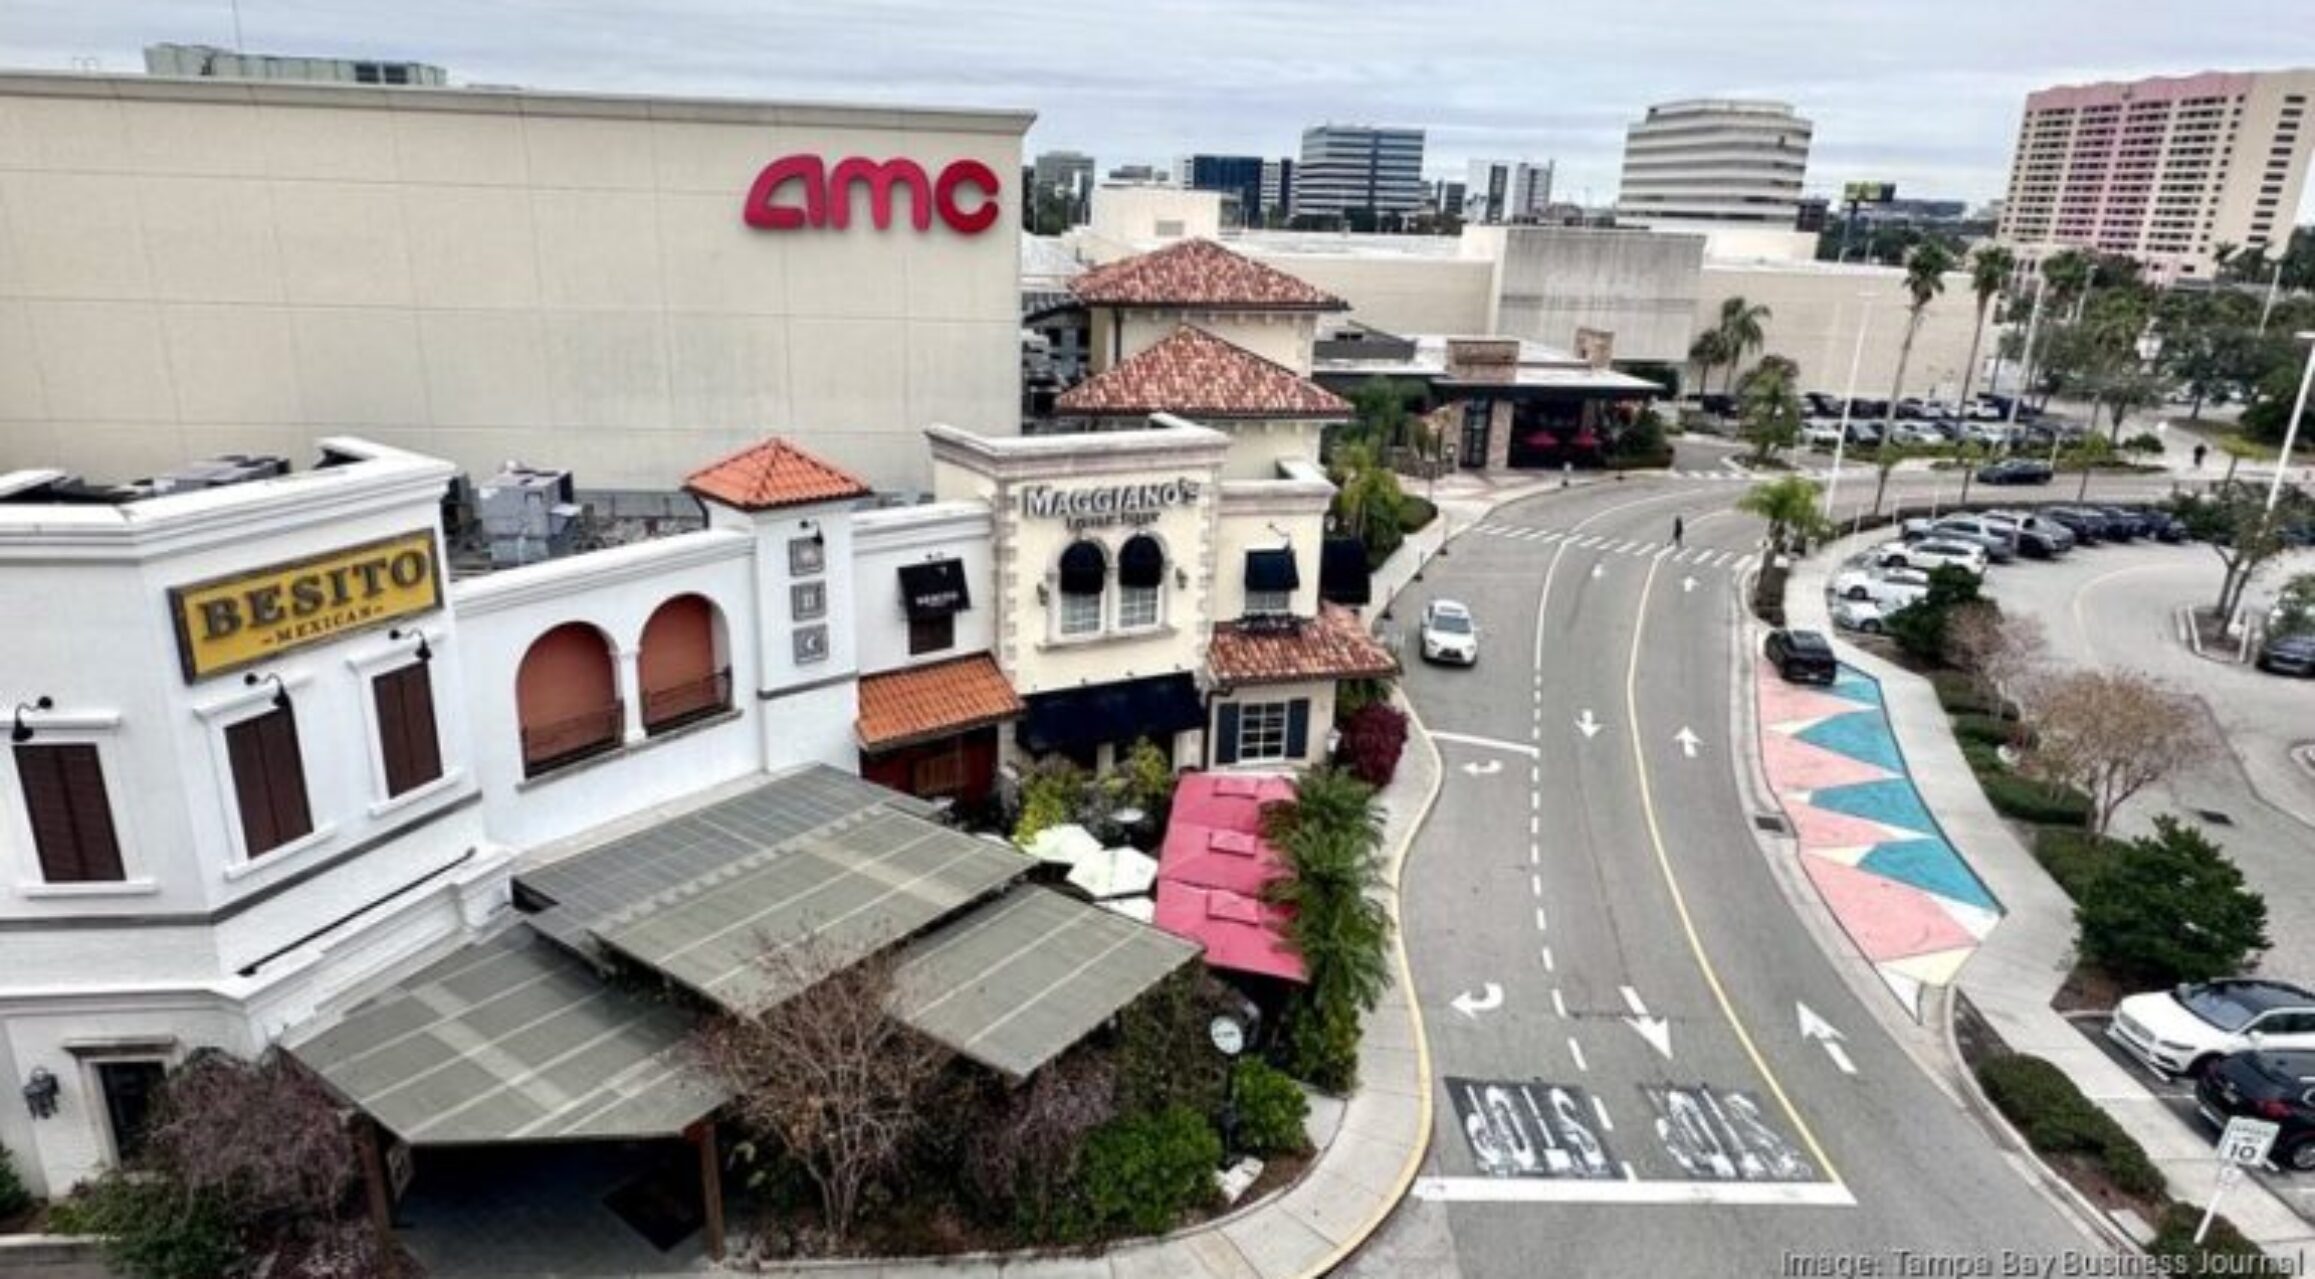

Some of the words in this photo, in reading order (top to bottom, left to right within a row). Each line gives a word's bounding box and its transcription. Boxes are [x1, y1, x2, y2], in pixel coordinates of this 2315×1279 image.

[198, 550, 427, 640] BESITO
[1466, 1085, 1604, 1176] STOP
[2230, 1143, 2256, 1161] 10
